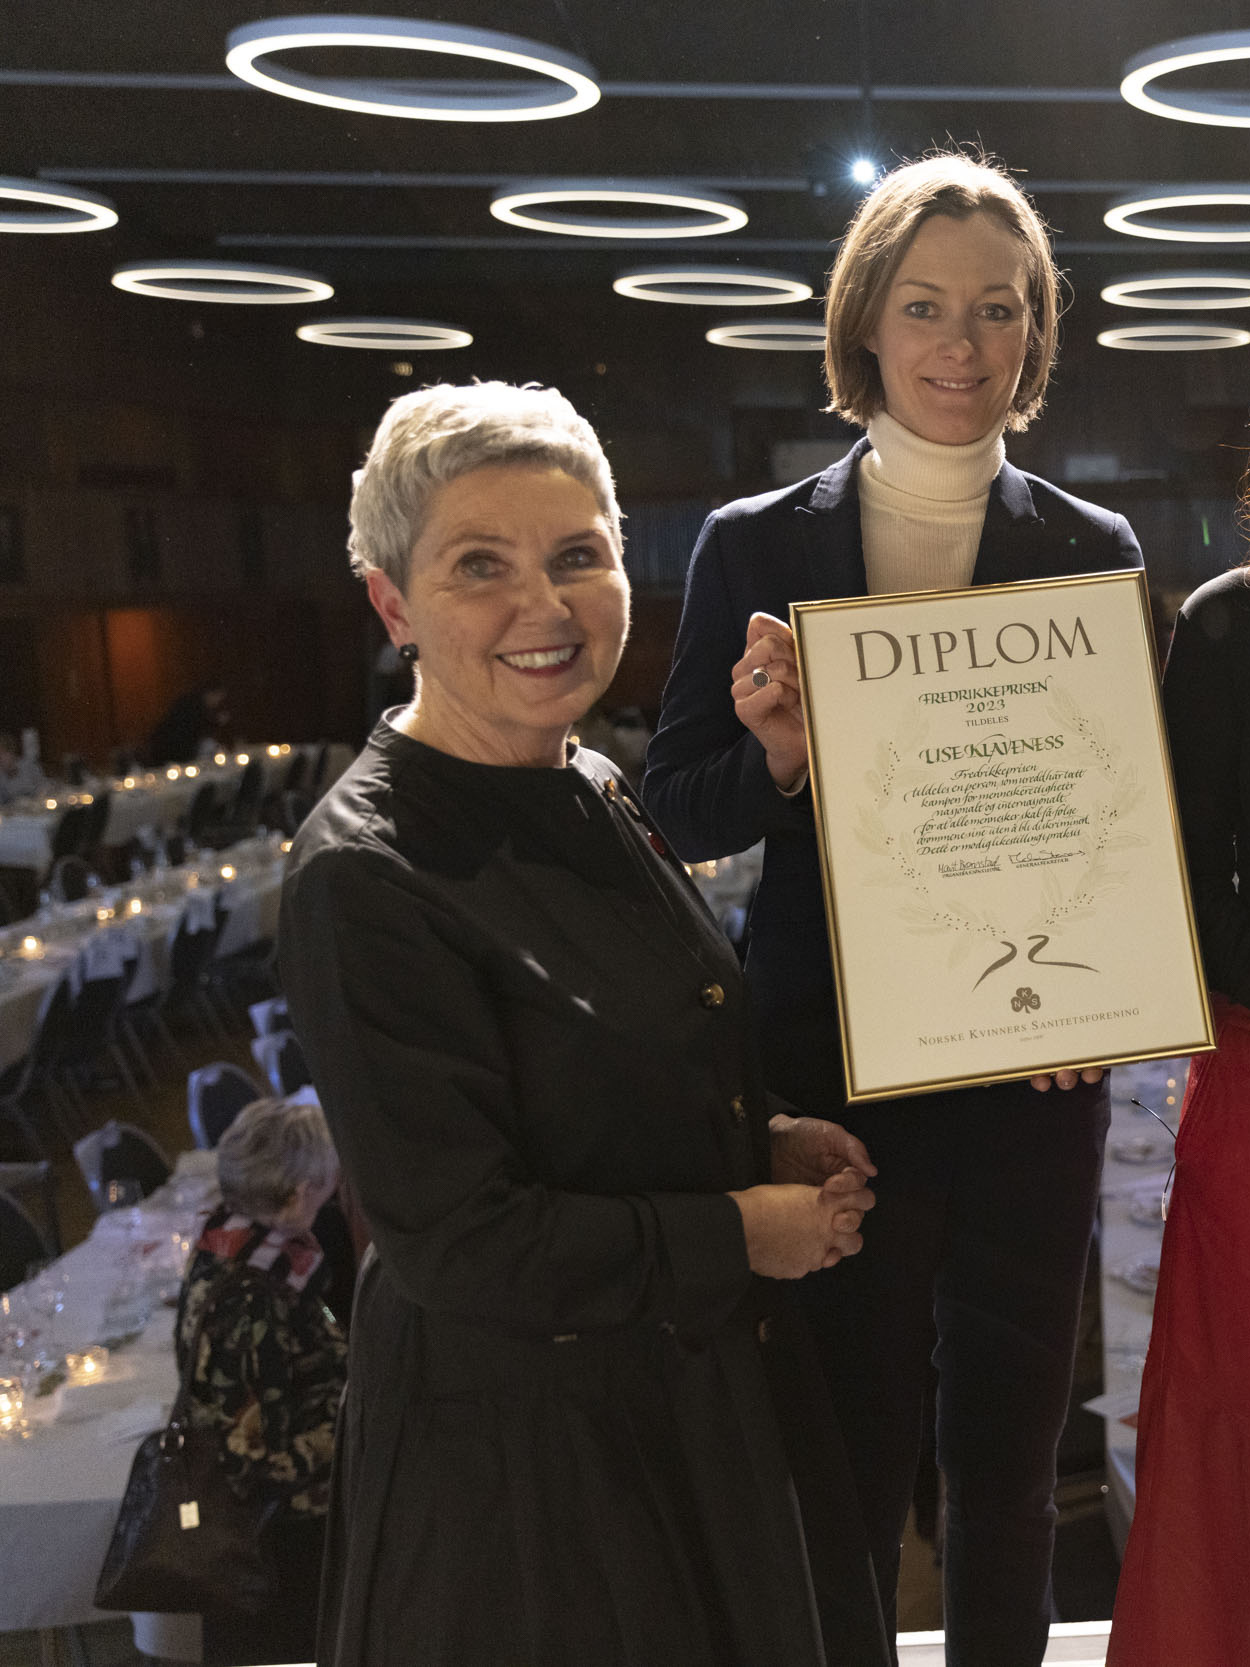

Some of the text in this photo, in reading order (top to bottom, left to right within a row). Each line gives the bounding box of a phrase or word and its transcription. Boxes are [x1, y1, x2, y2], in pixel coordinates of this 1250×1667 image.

[851, 616, 1097, 682] DIPLOM
[919, 676, 1052, 705] FREDRIKKEPRISEN
[966, 700, 1006, 714] 2023
[965, 715, 1009, 728] TILDELES
[919, 733, 1064, 764] LISE KLAVENESS
[905, 783, 950, 800] tildeles
[951, 784, 963, 793] en
[1001, 778, 1018, 786] som
[1019, 770, 1046, 784] uredd
[1045, 769, 1063, 781] har
[1064, 768, 1087, 780] tatt
[951, 763, 1037, 780] Fredrikkeprisen
[921, 782, 1076, 808] kampen for menneskerettigheter
[914, 804, 1077, 836] for at alle mennesker skal få følge
[933, 802, 983, 819] nasjonalt
[985, 803, 996, 815] og
[917, 832, 965, 845] drømmene
[968, 829, 986, 838] sine
[989, 825, 1009, 835] uten
[1010, 823, 1017, 833] å
[1018, 820, 1030, 832] bli
[917, 843, 948, 855] Dette
[962, 838, 991, 853] modig
[918, 1031, 965, 1047] NORSKE
[968, 1023, 1028, 1040] KVINNERS
[1030, 1007, 1141, 1031] SANITETSFORENING
